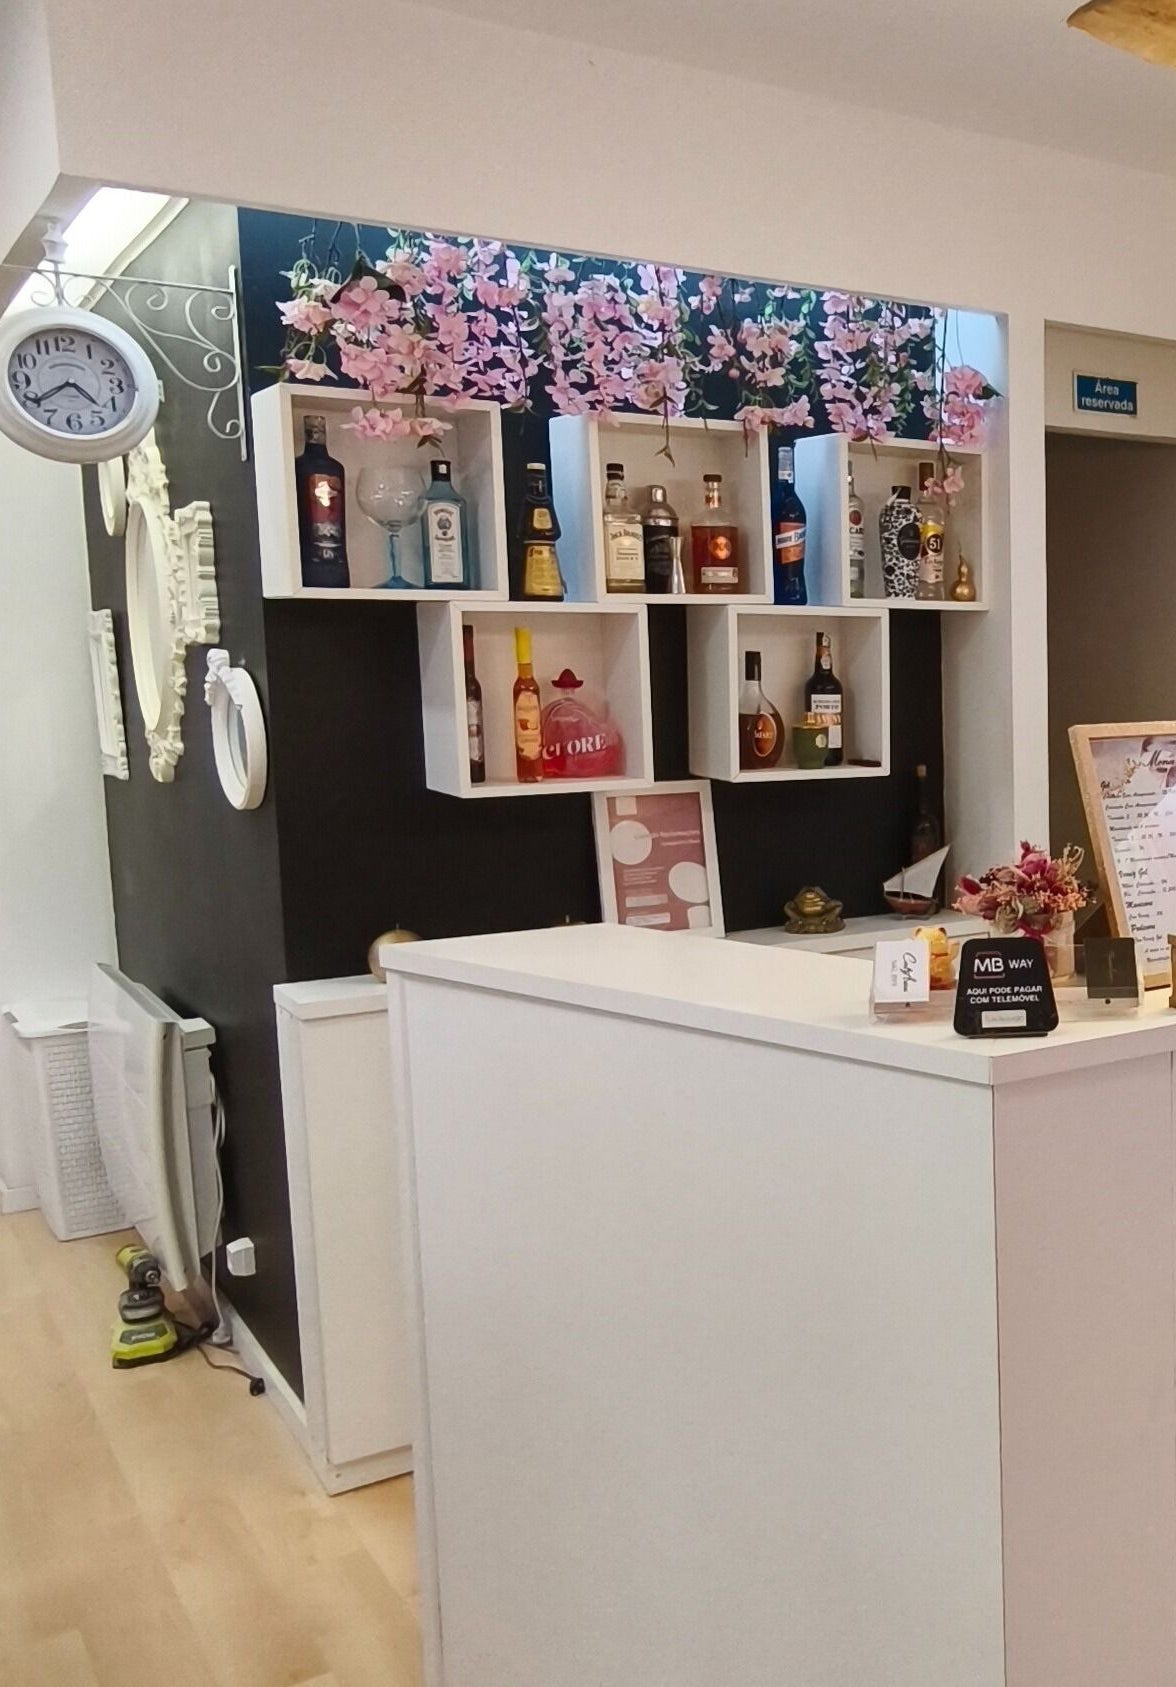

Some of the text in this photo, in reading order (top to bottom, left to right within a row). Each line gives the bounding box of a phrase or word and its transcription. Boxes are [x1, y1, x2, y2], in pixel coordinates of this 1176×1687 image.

[35, 338, 50, 356] 11
[54, 335, 76, 353] 12
[86, 343, 92, 360] 1
[17, 353, 37, 370] 10
[100, 359, 116, 376] 2
[11, 370, 31, 390] 9
[109, 377, 124, 395] 3
[1094, 379, 1120, 396] Área
[23, 390, 42, 408] 8
[100, 396, 117, 412] 4
[1081, 396, 1134, 412] reservada
[43, 408, 58, 425] 7
[65, 412, 83, 431] 6
[90, 410, 105, 426] 5
[929, 537, 941, 550] 51
[974, 957, 1034, 973] MB WAY
[966, 985, 1043, 996] AQUI PODE PAGAR
[970, 996, 989, 1004] COM
